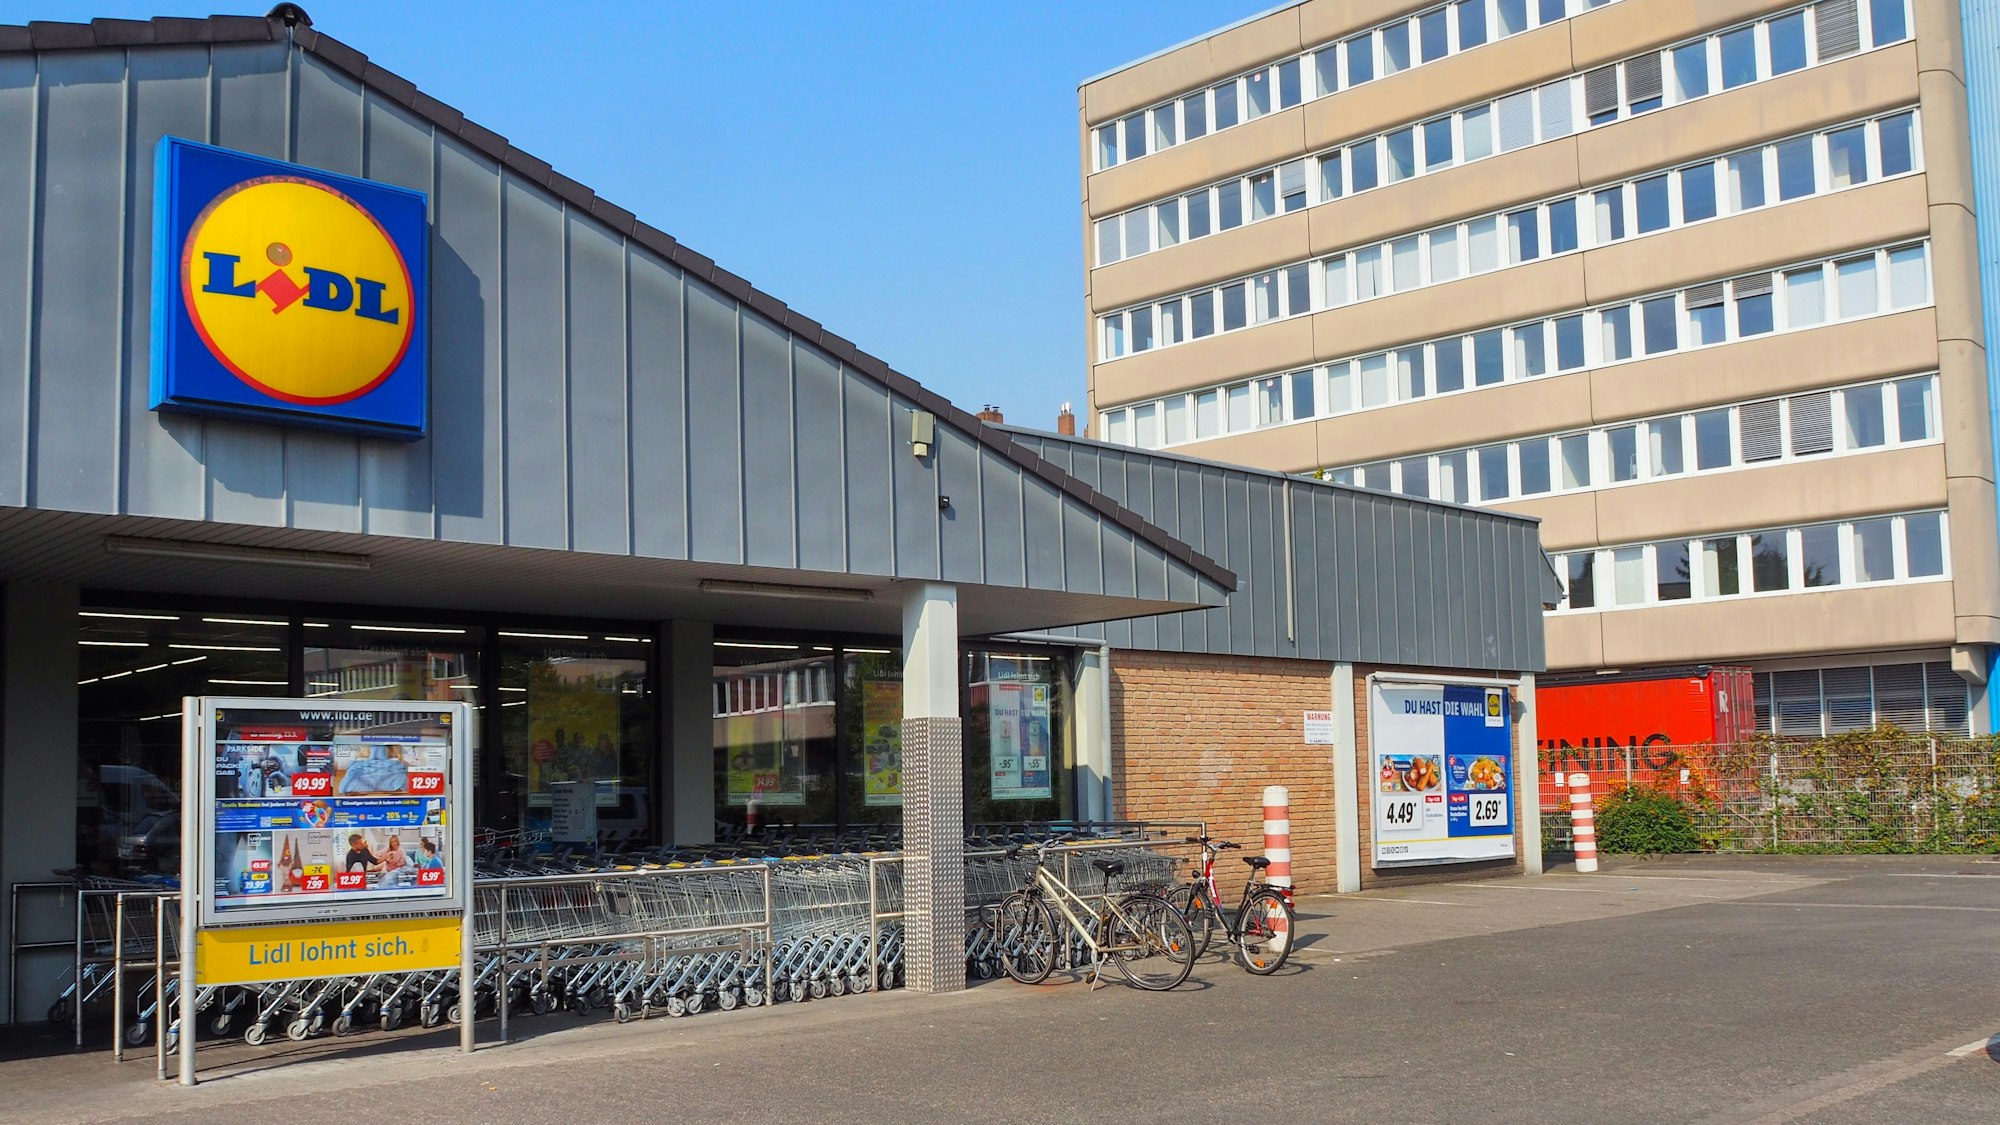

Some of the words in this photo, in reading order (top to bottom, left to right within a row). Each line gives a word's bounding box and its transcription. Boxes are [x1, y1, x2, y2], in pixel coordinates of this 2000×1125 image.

[202, 242, 399, 325] LIDL
[998, 671, 1010, 679] Lidl
[1405, 699, 1417, 714] DU
[1420, 700, 1442, 715] HAST
[1444, 701, 1460, 716] DIE
[1460, 702, 1485, 717] WAHL
[1719, 690, 1729, 713] R
[227, 745, 264, 753] PARKSIDE
[1537, 733, 1678, 773] INING
[311, 866, 323, 874] -7€
[249, 943, 291, 965] Lidl
[300, 940, 357, 961] lohnt
[365, 936, 415, 958] sich.
